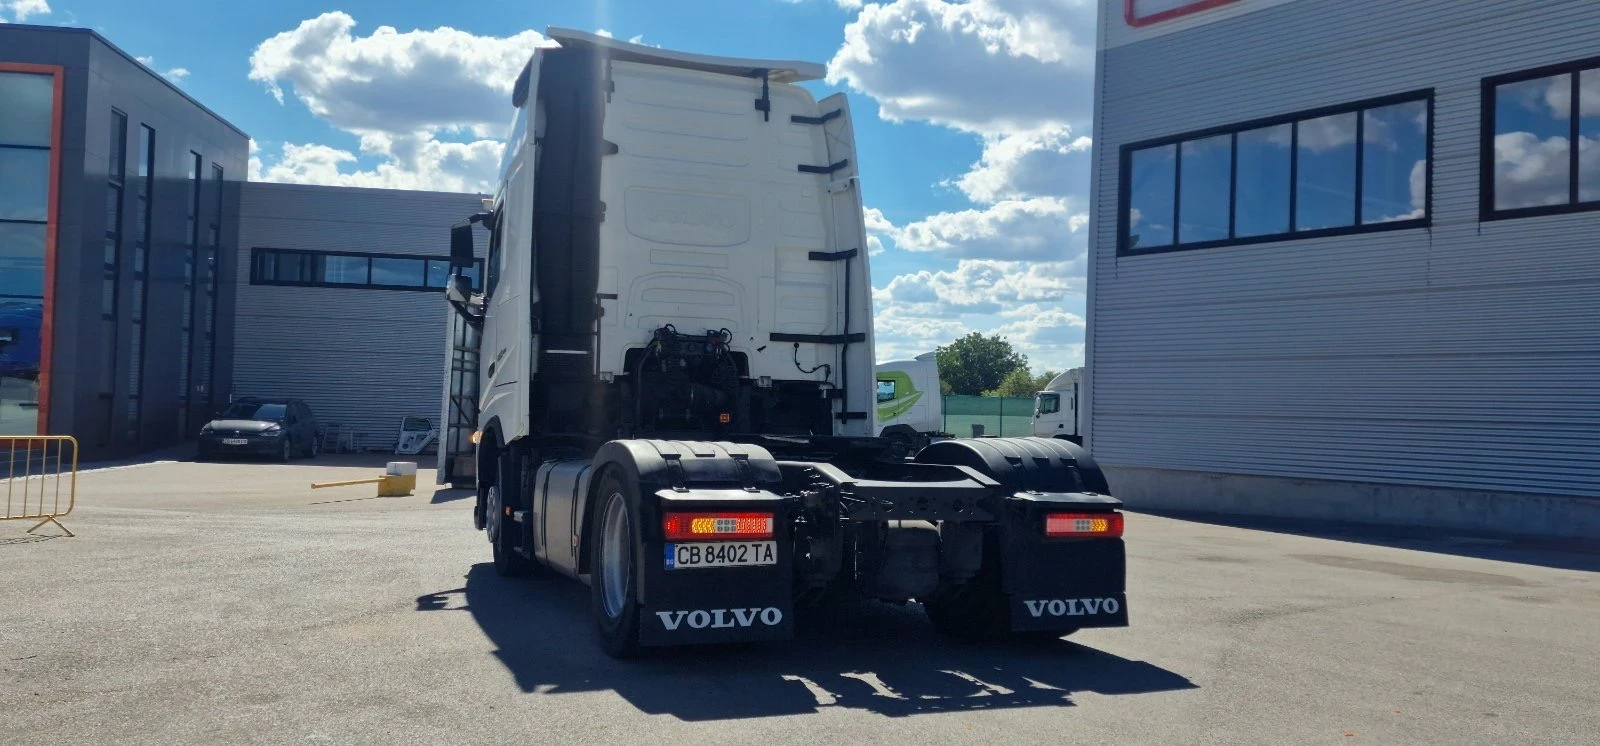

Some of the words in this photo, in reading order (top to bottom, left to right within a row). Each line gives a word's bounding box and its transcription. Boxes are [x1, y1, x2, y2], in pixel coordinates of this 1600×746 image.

[677, 546, 701, 565] CB
[705, 545, 748, 564] 8402
[752, 544, 773, 562] TA
[1023, 597, 1120, 617] VOLVO
[655, 607, 782, 631] VOLVO
